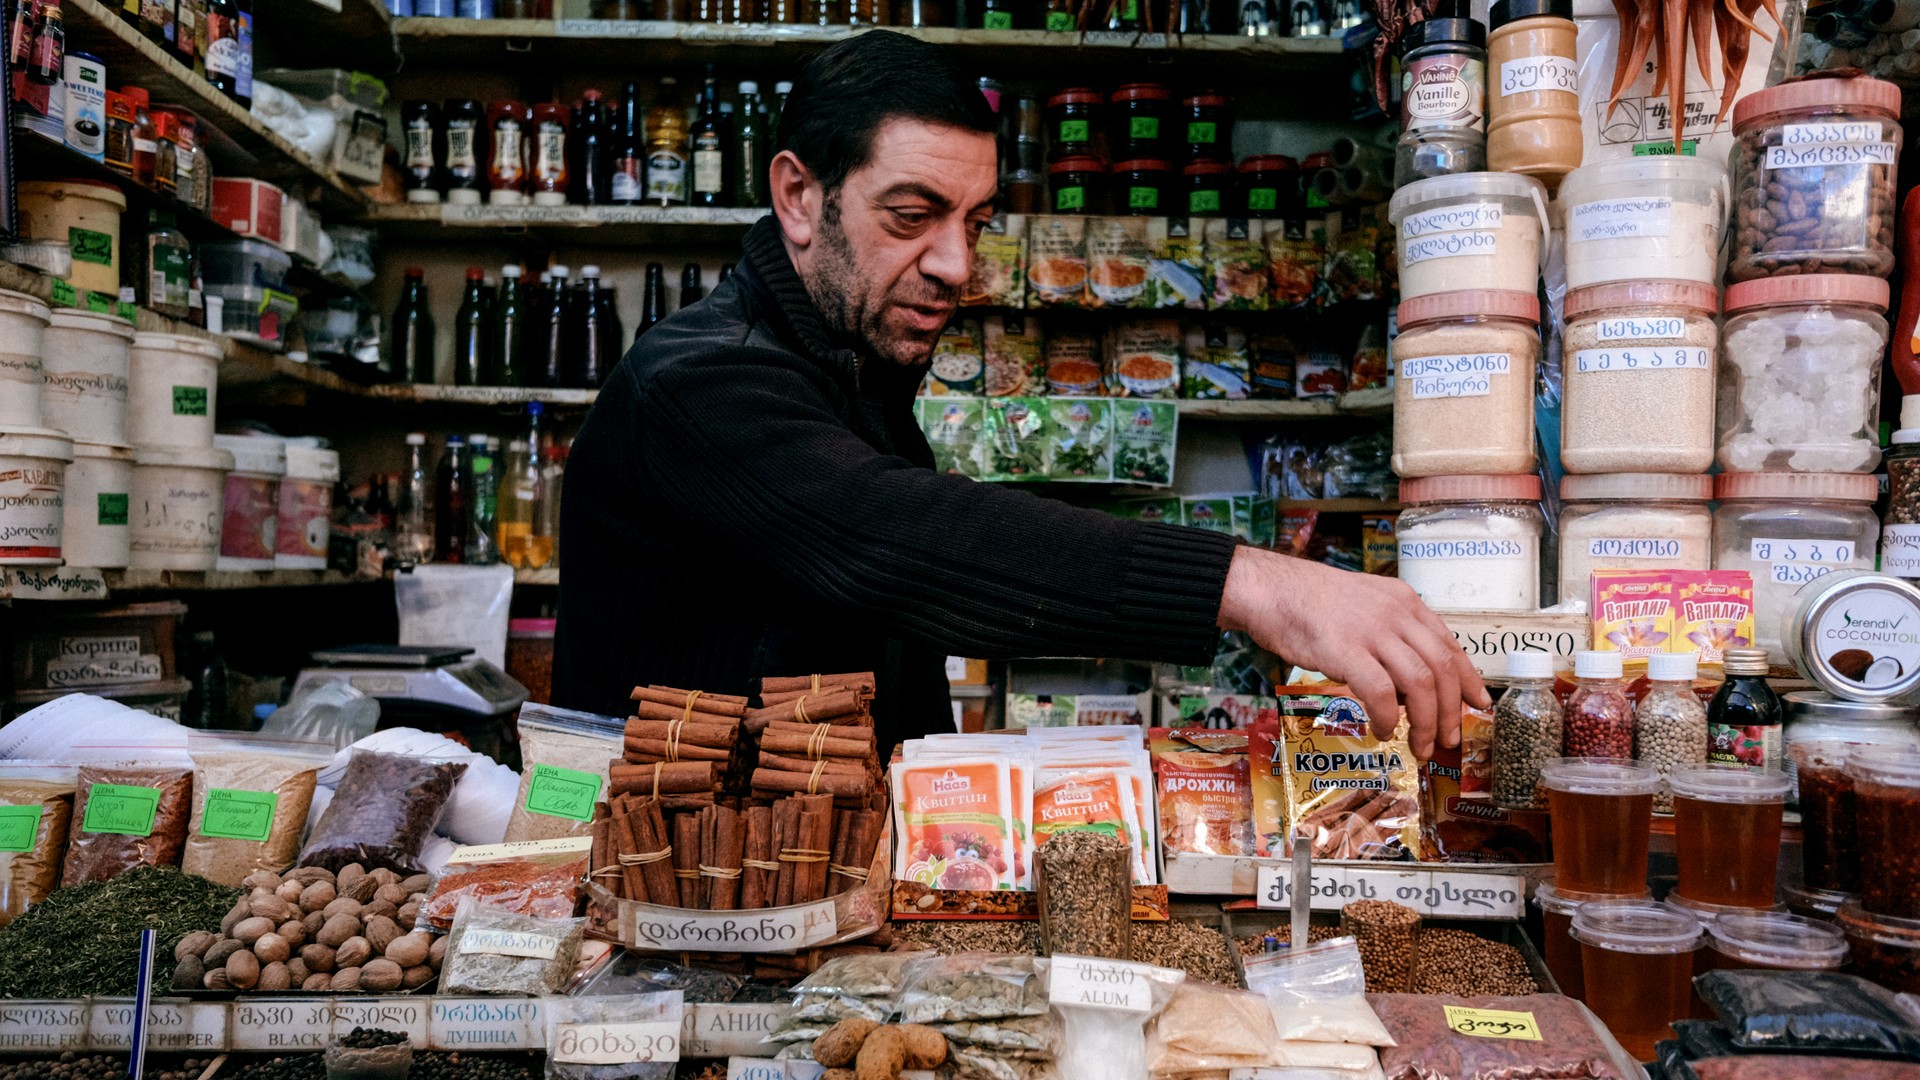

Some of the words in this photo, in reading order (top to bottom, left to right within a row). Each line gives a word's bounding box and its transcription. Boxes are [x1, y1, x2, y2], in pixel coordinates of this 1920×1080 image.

[1416, 87, 1460, 100] Vanille
[1418, 100, 1456, 110] Bourbon
[1789, 125, 1875, 144] კაკაოს
[1774, 144, 1893, 165] მარცვალი
[1404, 205, 1500, 235] იტალიური
[1405, 231, 1495, 262] ჟელატინი
[1602, 319, 1681, 337] სეზამი
[1405, 355, 1508, 374] ჟელატინი
[1415, 376, 1488, 397] ჩინური
[1401, 540, 1521, 558] ლიმონმჟავა
[1591, 538, 1680, 557] ქოქოსი
[61, 637, 138, 657] Корица
[538, 766, 559, 776] ЦЕНА
[1295, 752, 1406, 774] КОРИЦА
[95, 787, 115, 795] ЦЕНА
[934, 781, 968, 792] Haas
[1167, 778, 1235, 793] ДРОЖЖИ
[1313, 777, 1388, 791] (молотая)
[211, 791, 232, 799] ЦЕНА
[1055, 791, 1090, 802] Haas
[1396, 881, 1517, 910] თესლი
[638, 918, 796, 945] დარიჩინი
[1077, 962, 1135, 985] შაბი
[1080, 990, 1129, 1007] ALUM
[105, 1009, 183, 1026] წიაკა
[237, 1007, 293, 1026] შავი
[306, 1007, 417, 1025] პილპილი
[710, 1013, 780, 1031] АНИС
[269, 1034, 322, 1046] BLACK
[445, 1031, 518, 1045] ДУШИЦА
